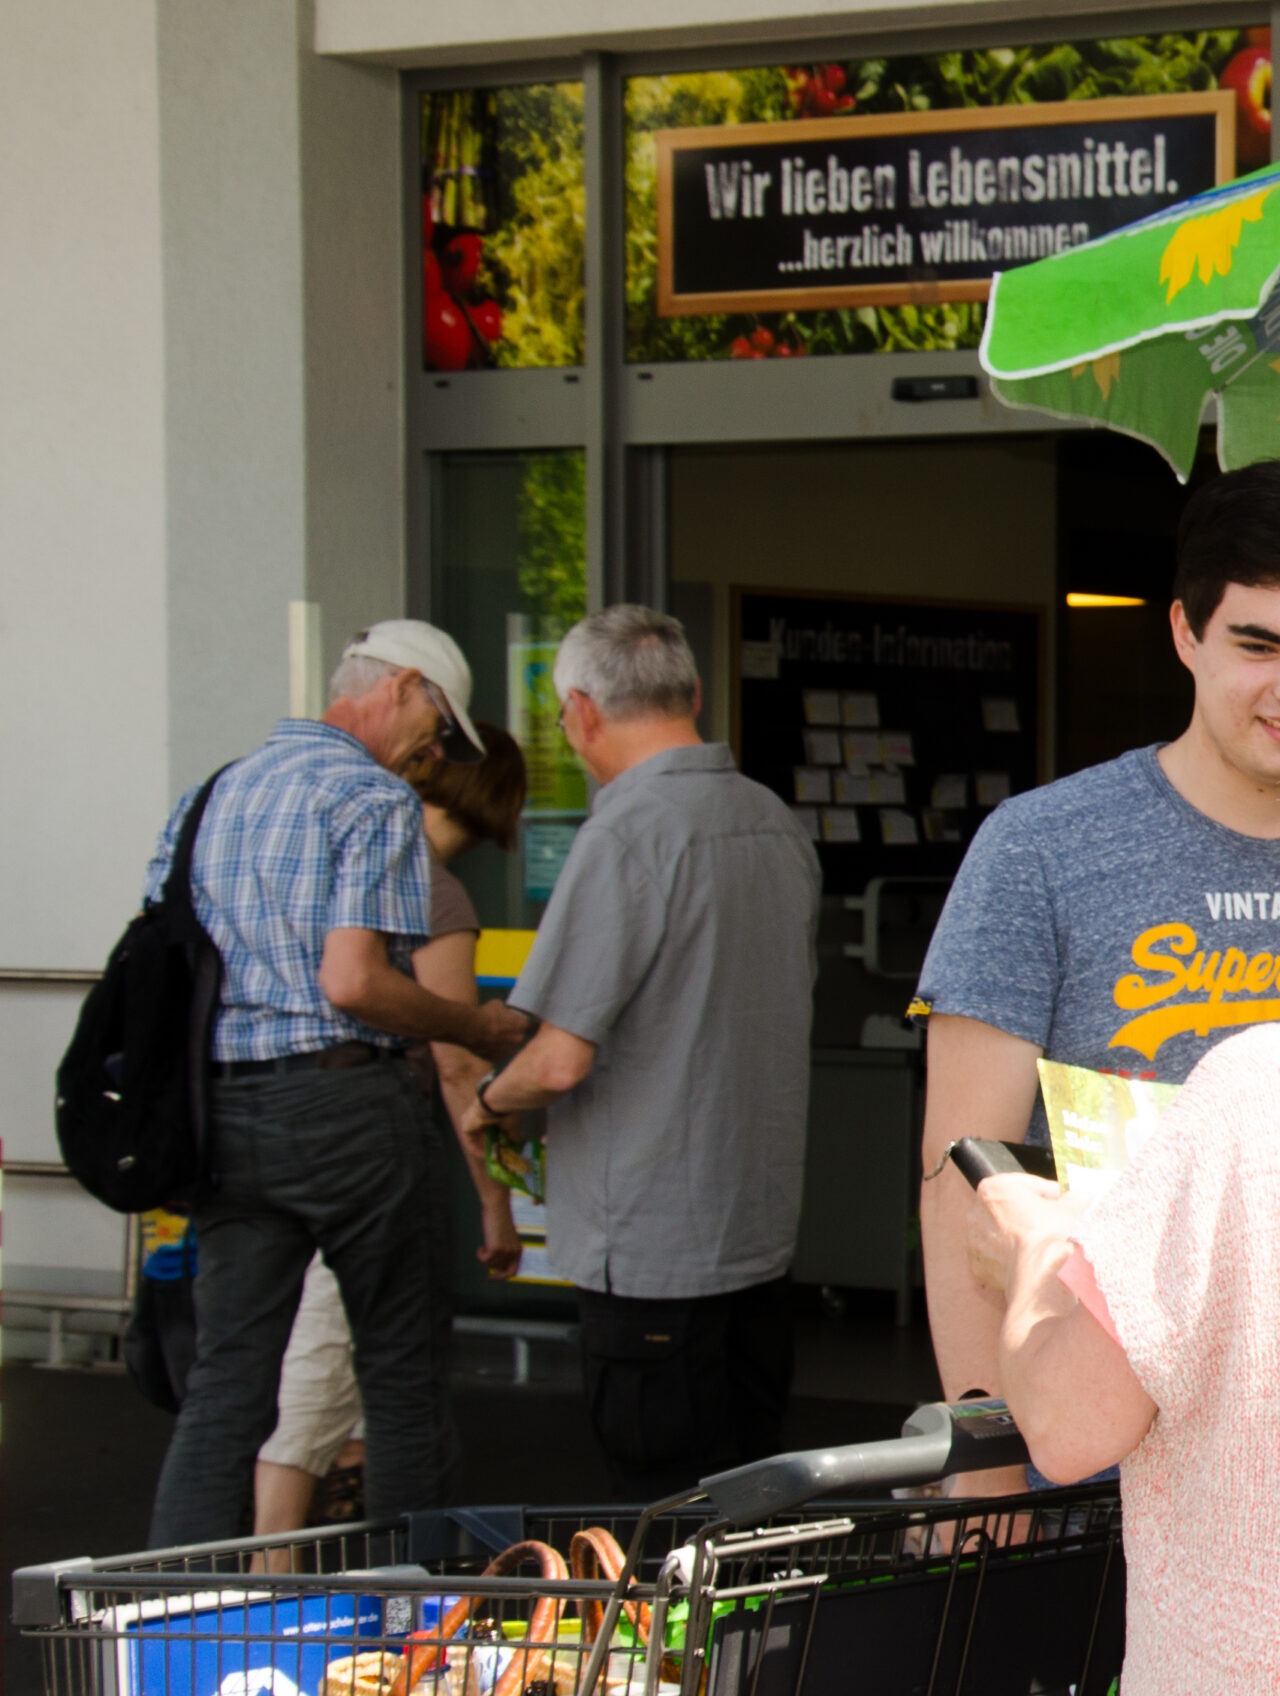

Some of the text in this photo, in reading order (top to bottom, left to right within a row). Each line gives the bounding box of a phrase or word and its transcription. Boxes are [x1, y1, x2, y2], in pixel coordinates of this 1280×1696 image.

[705, 161, 770, 219] Wir
[781, 155, 896, 216] lieben
[907, 134, 1178, 208] Lebensmittel.
[920, 219, 1089, 266] willkommen
